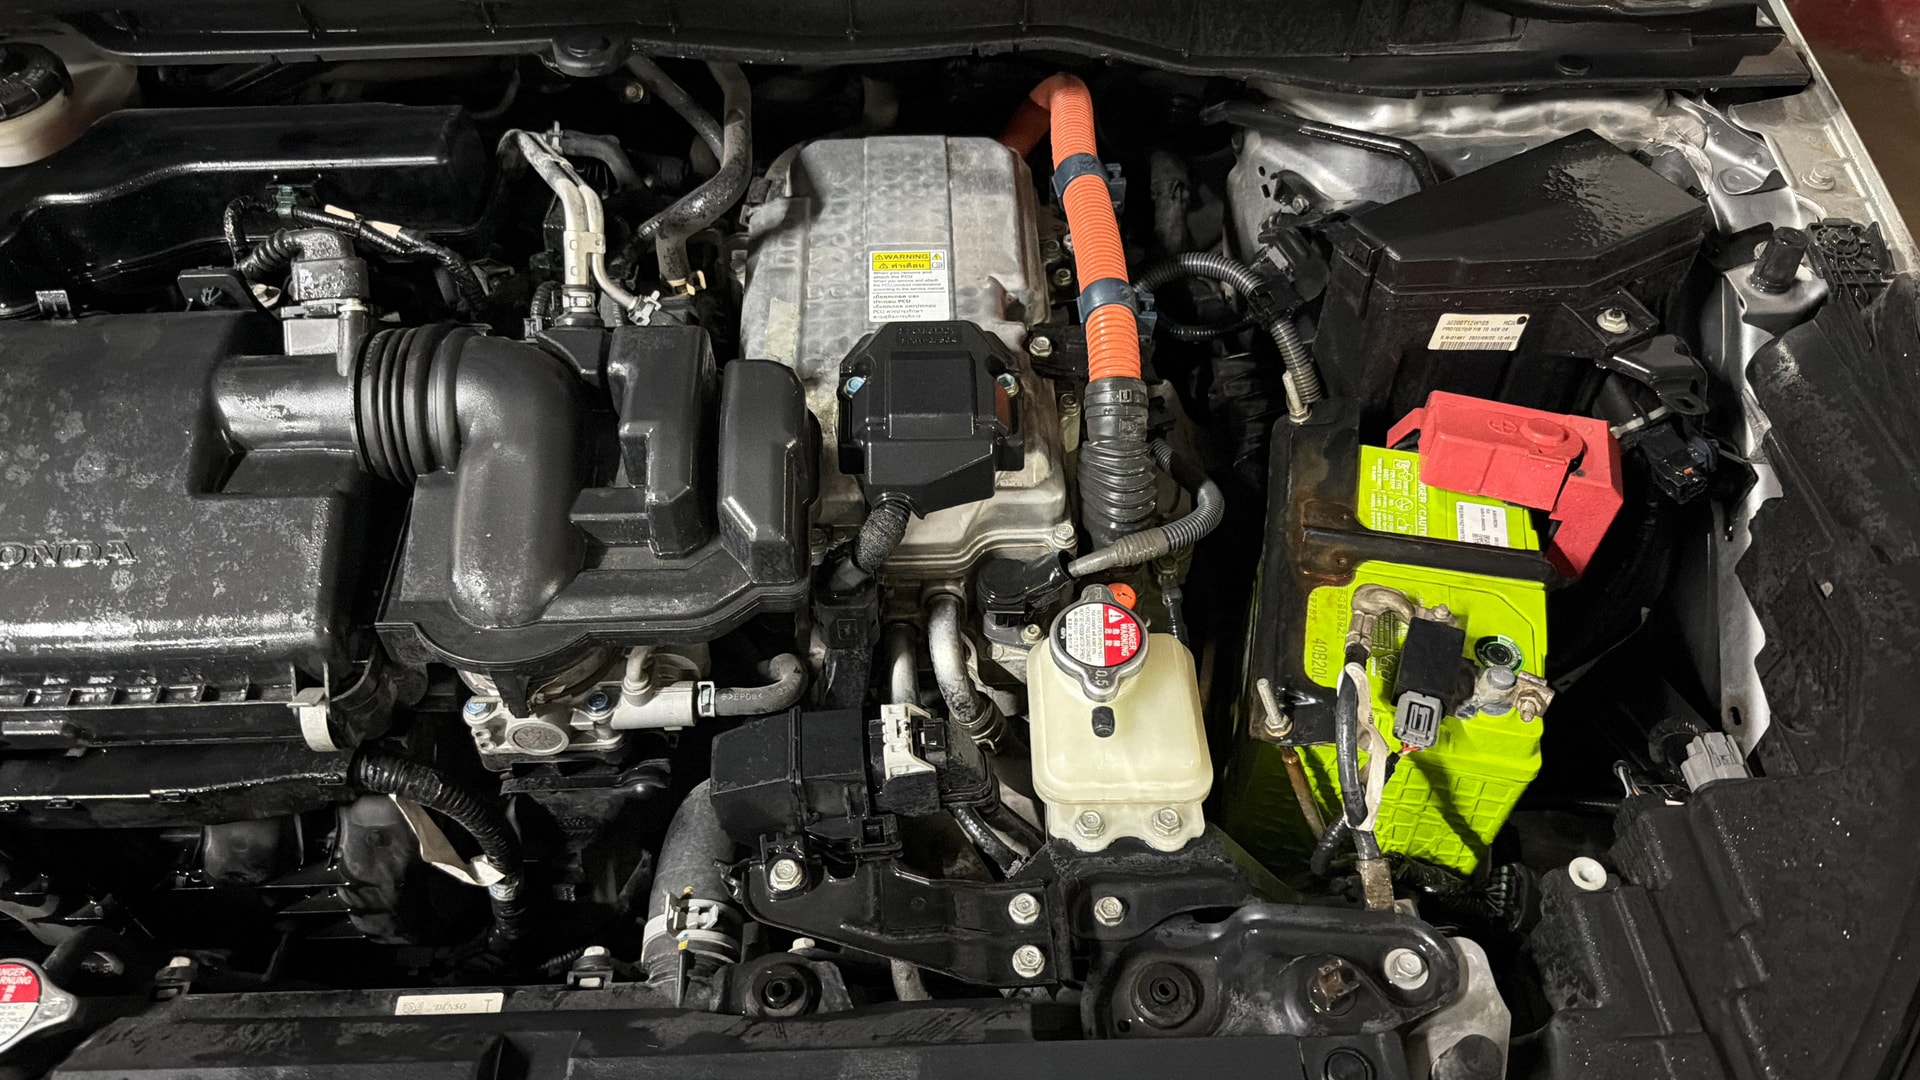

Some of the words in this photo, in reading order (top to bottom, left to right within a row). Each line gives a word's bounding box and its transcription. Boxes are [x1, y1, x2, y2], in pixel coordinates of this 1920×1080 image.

[1418, 509, 1428, 536] CAUTI
[1120, 623, 1130, 657] WARNUNG
[1127, 623, 1138, 651] DANGER
[1311, 638, 1328, 680] 40B20L
[1095, 670, 1109, 687] 0.5
[0, 976, 33, 985] RNUNG
[435, 1002, 468, 1011] DENSO
